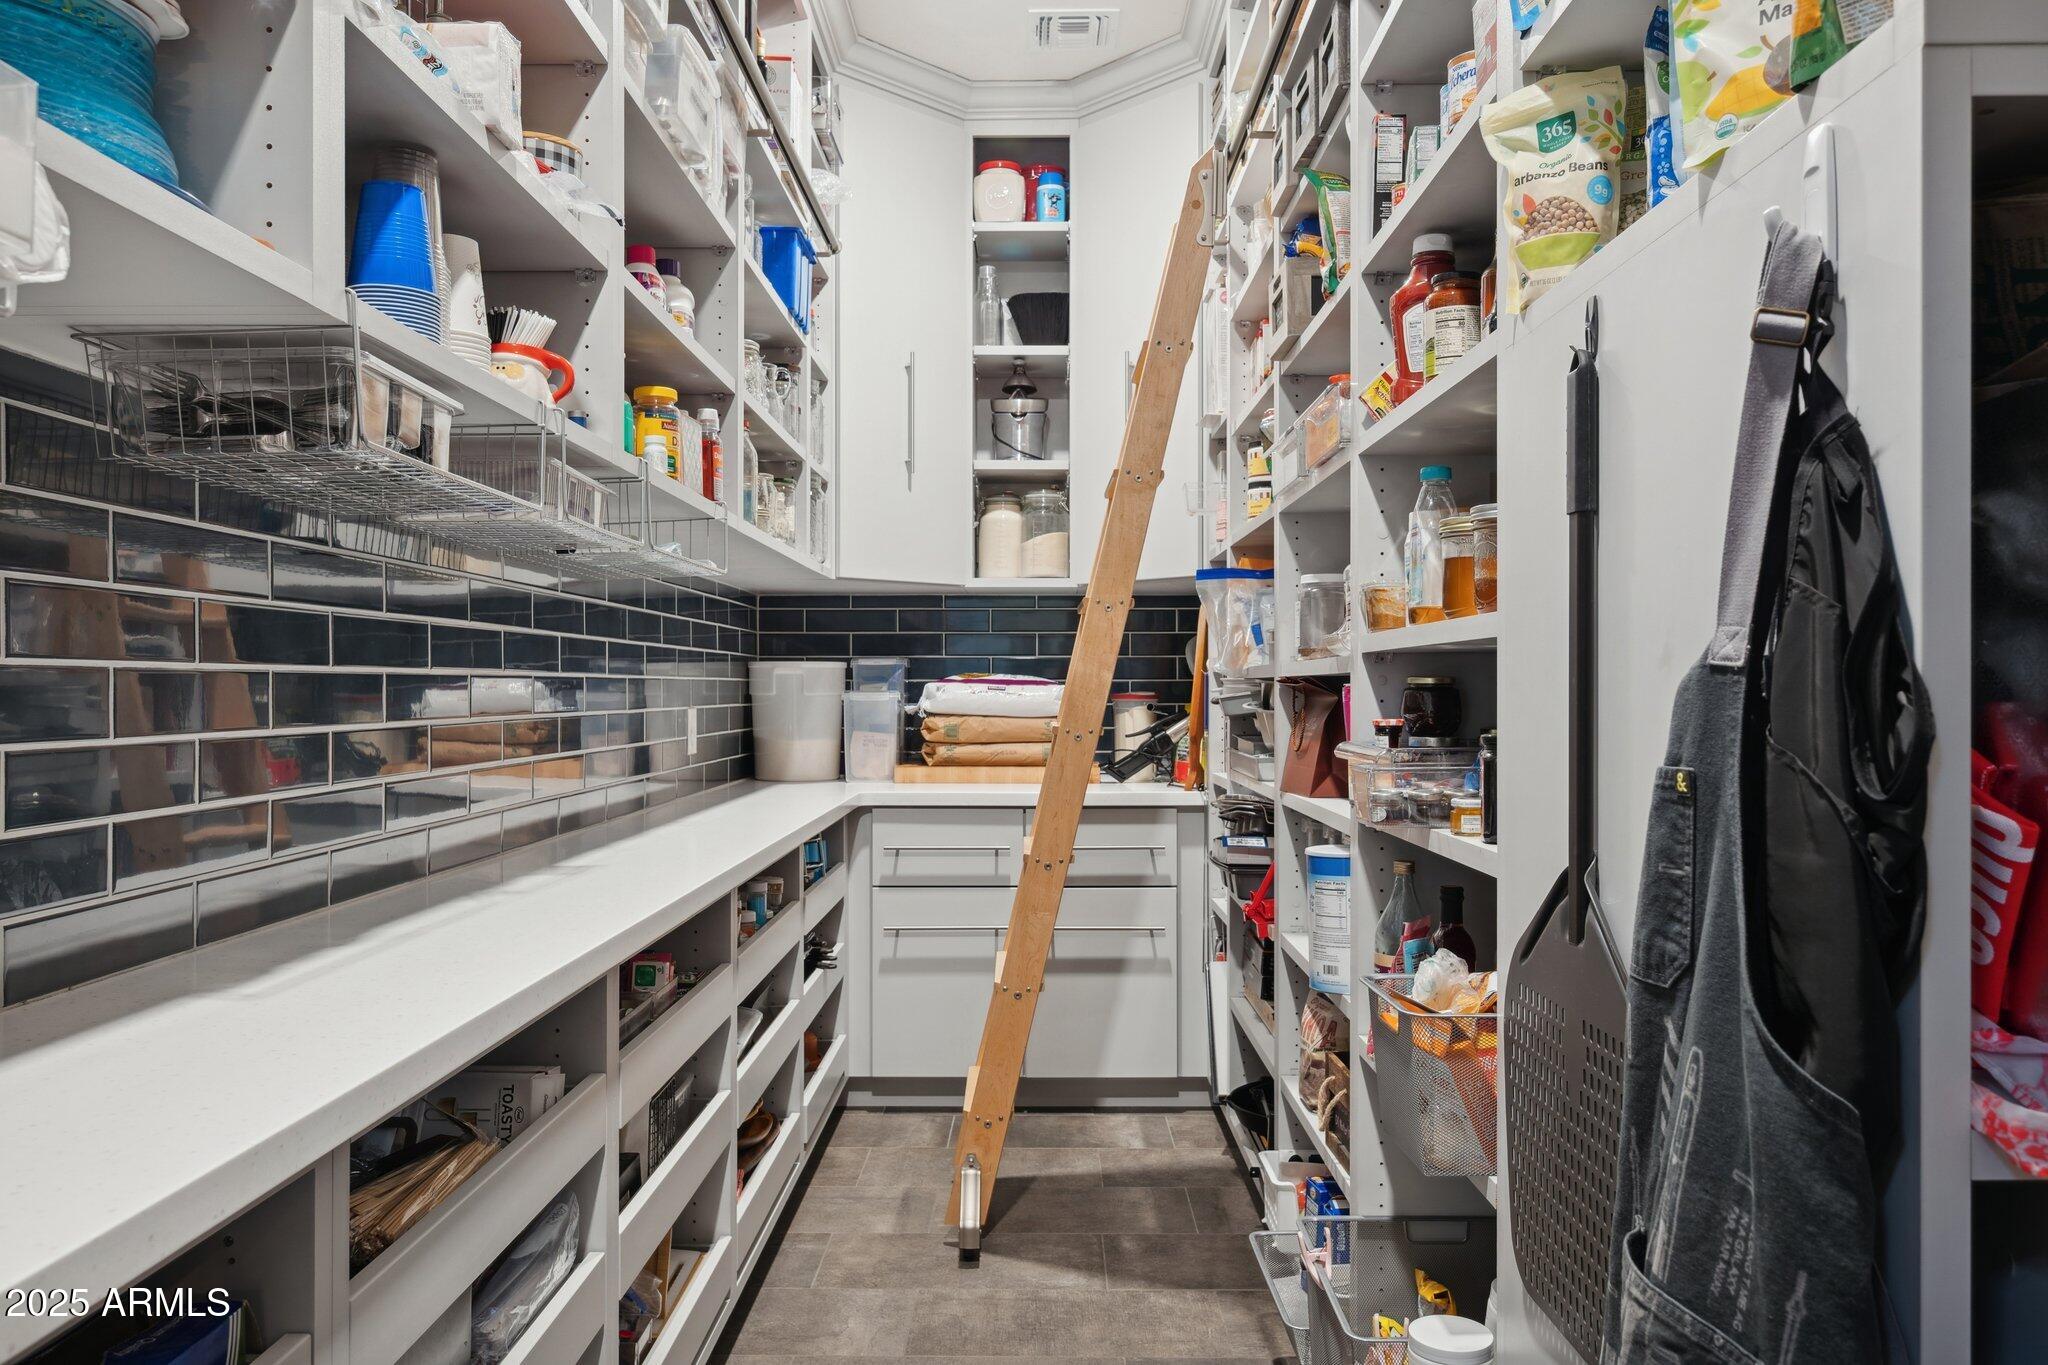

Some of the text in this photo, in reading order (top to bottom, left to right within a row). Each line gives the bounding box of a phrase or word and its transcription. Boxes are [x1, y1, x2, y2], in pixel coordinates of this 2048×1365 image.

[1541, 119, 1572, 142] 365
[1538, 153, 1573, 170] Organic
[1568, 161, 1609, 173] Beans
[500, 1084, 515, 1143] TOASTY
[1727, 1239, 1745, 1296] GALAXY
